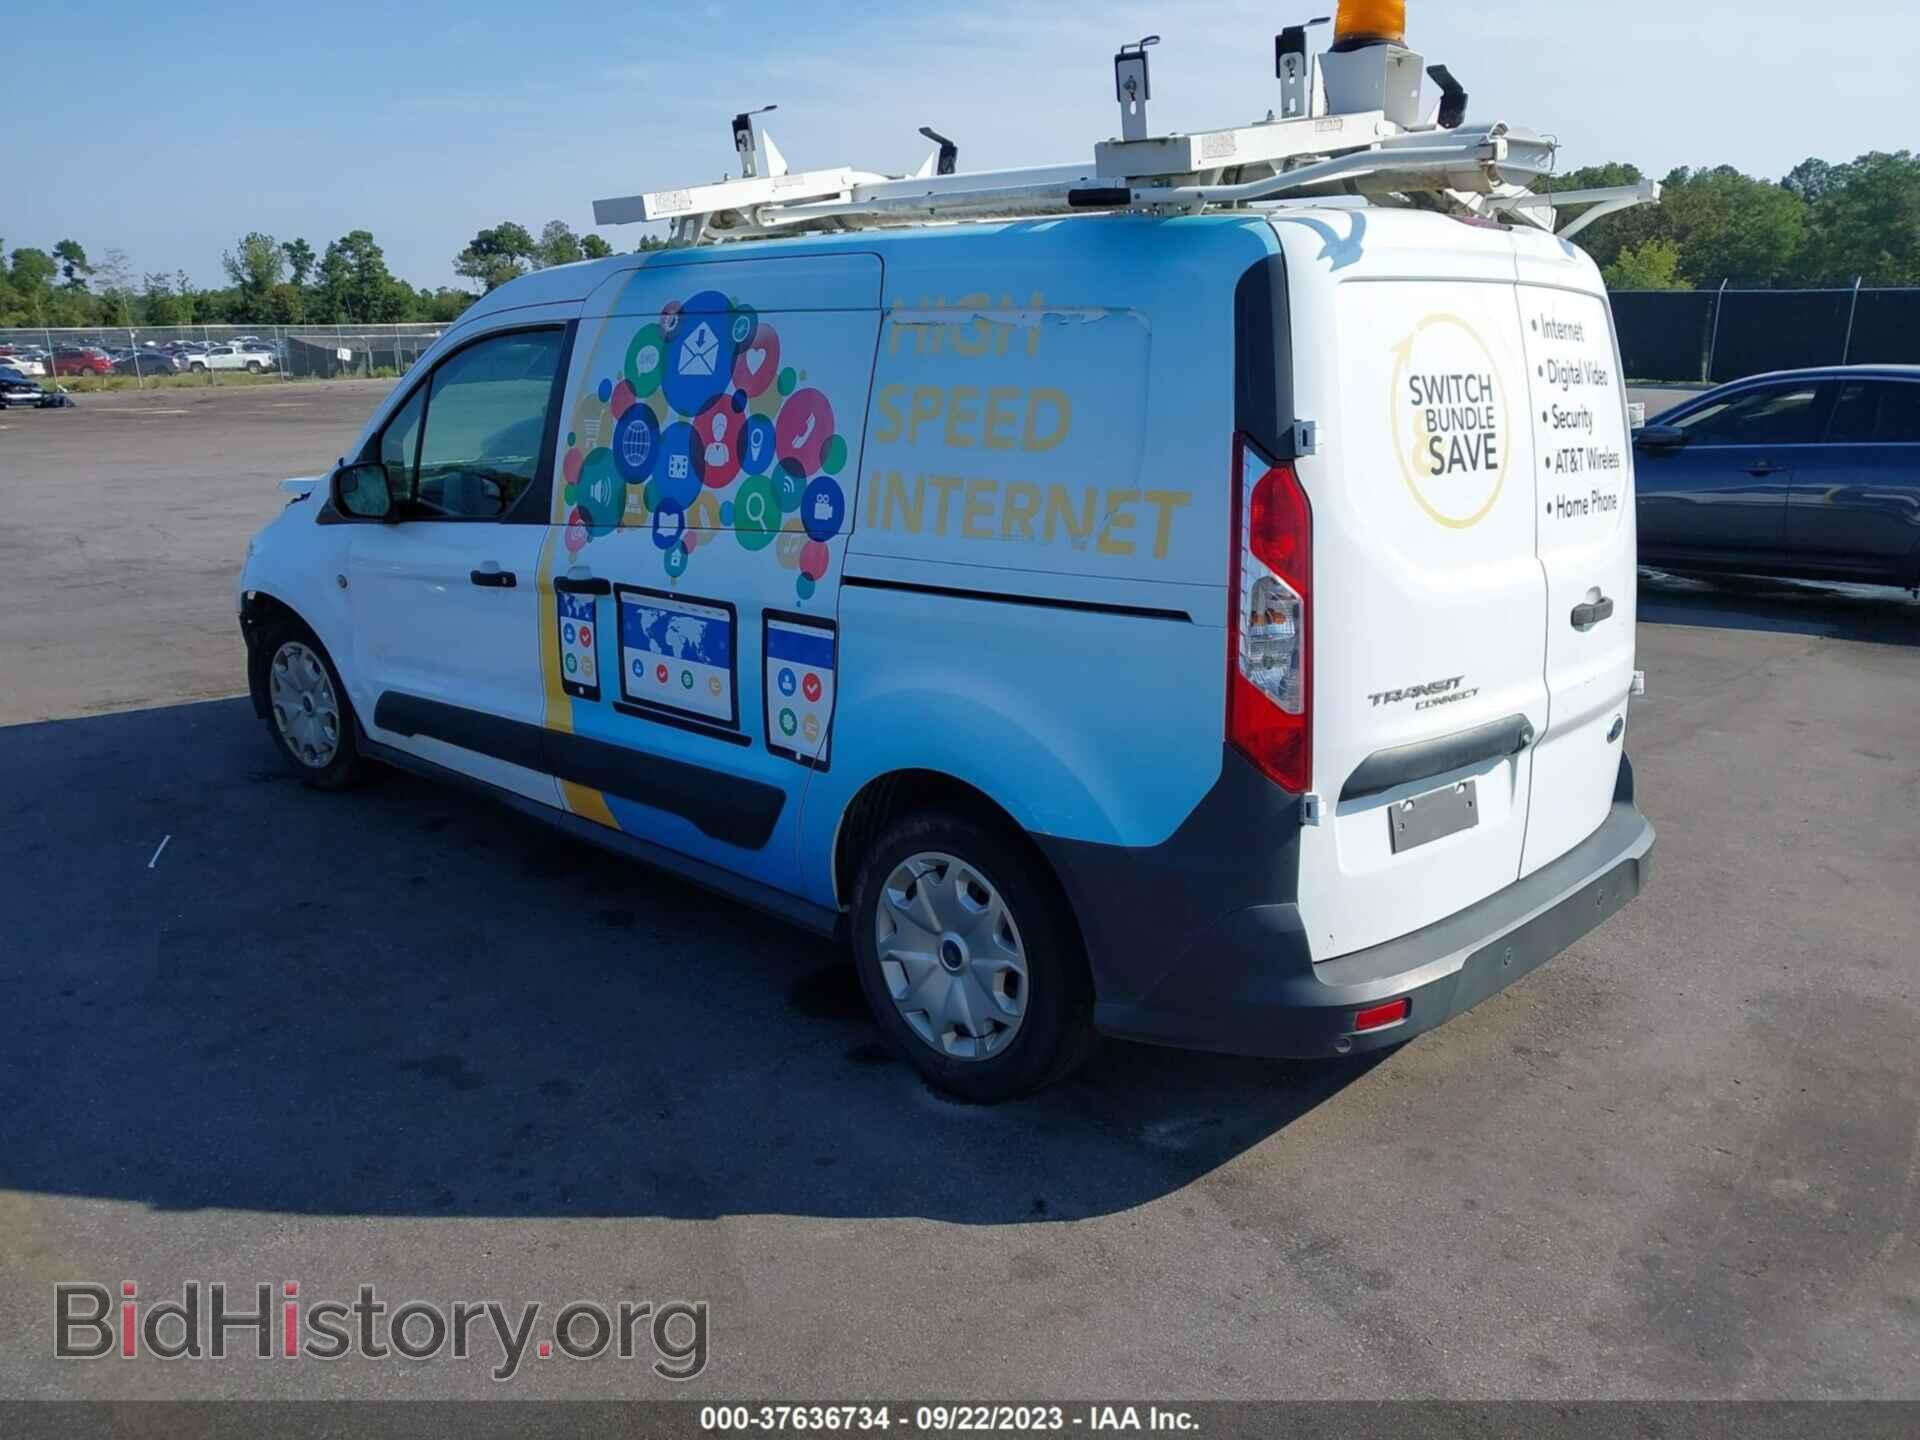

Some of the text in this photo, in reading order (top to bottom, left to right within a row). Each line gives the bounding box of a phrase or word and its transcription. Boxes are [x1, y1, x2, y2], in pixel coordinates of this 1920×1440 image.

[888, 290, 1046, 361] HIGH
[1540, 312, 1585, 343] Internet
[1408, 373, 1494, 406] SWITCH
[1546, 358, 1609, 392] Digital Video
[874, 383, 1073, 454] SPEED
[1425, 405, 1496, 433] BUNDLE
[1551, 403, 1594, 436] Security
[1428, 432, 1499, 476] SAVE
[1554, 445, 1621, 475] AT&T Wireless
[865, 470, 1195, 561] INTERNET
[1556, 488, 1618, 520] Home Phone
[1367, 675, 1465, 707] TRANSIT
[1415, 687, 1480, 711] CONNECT
